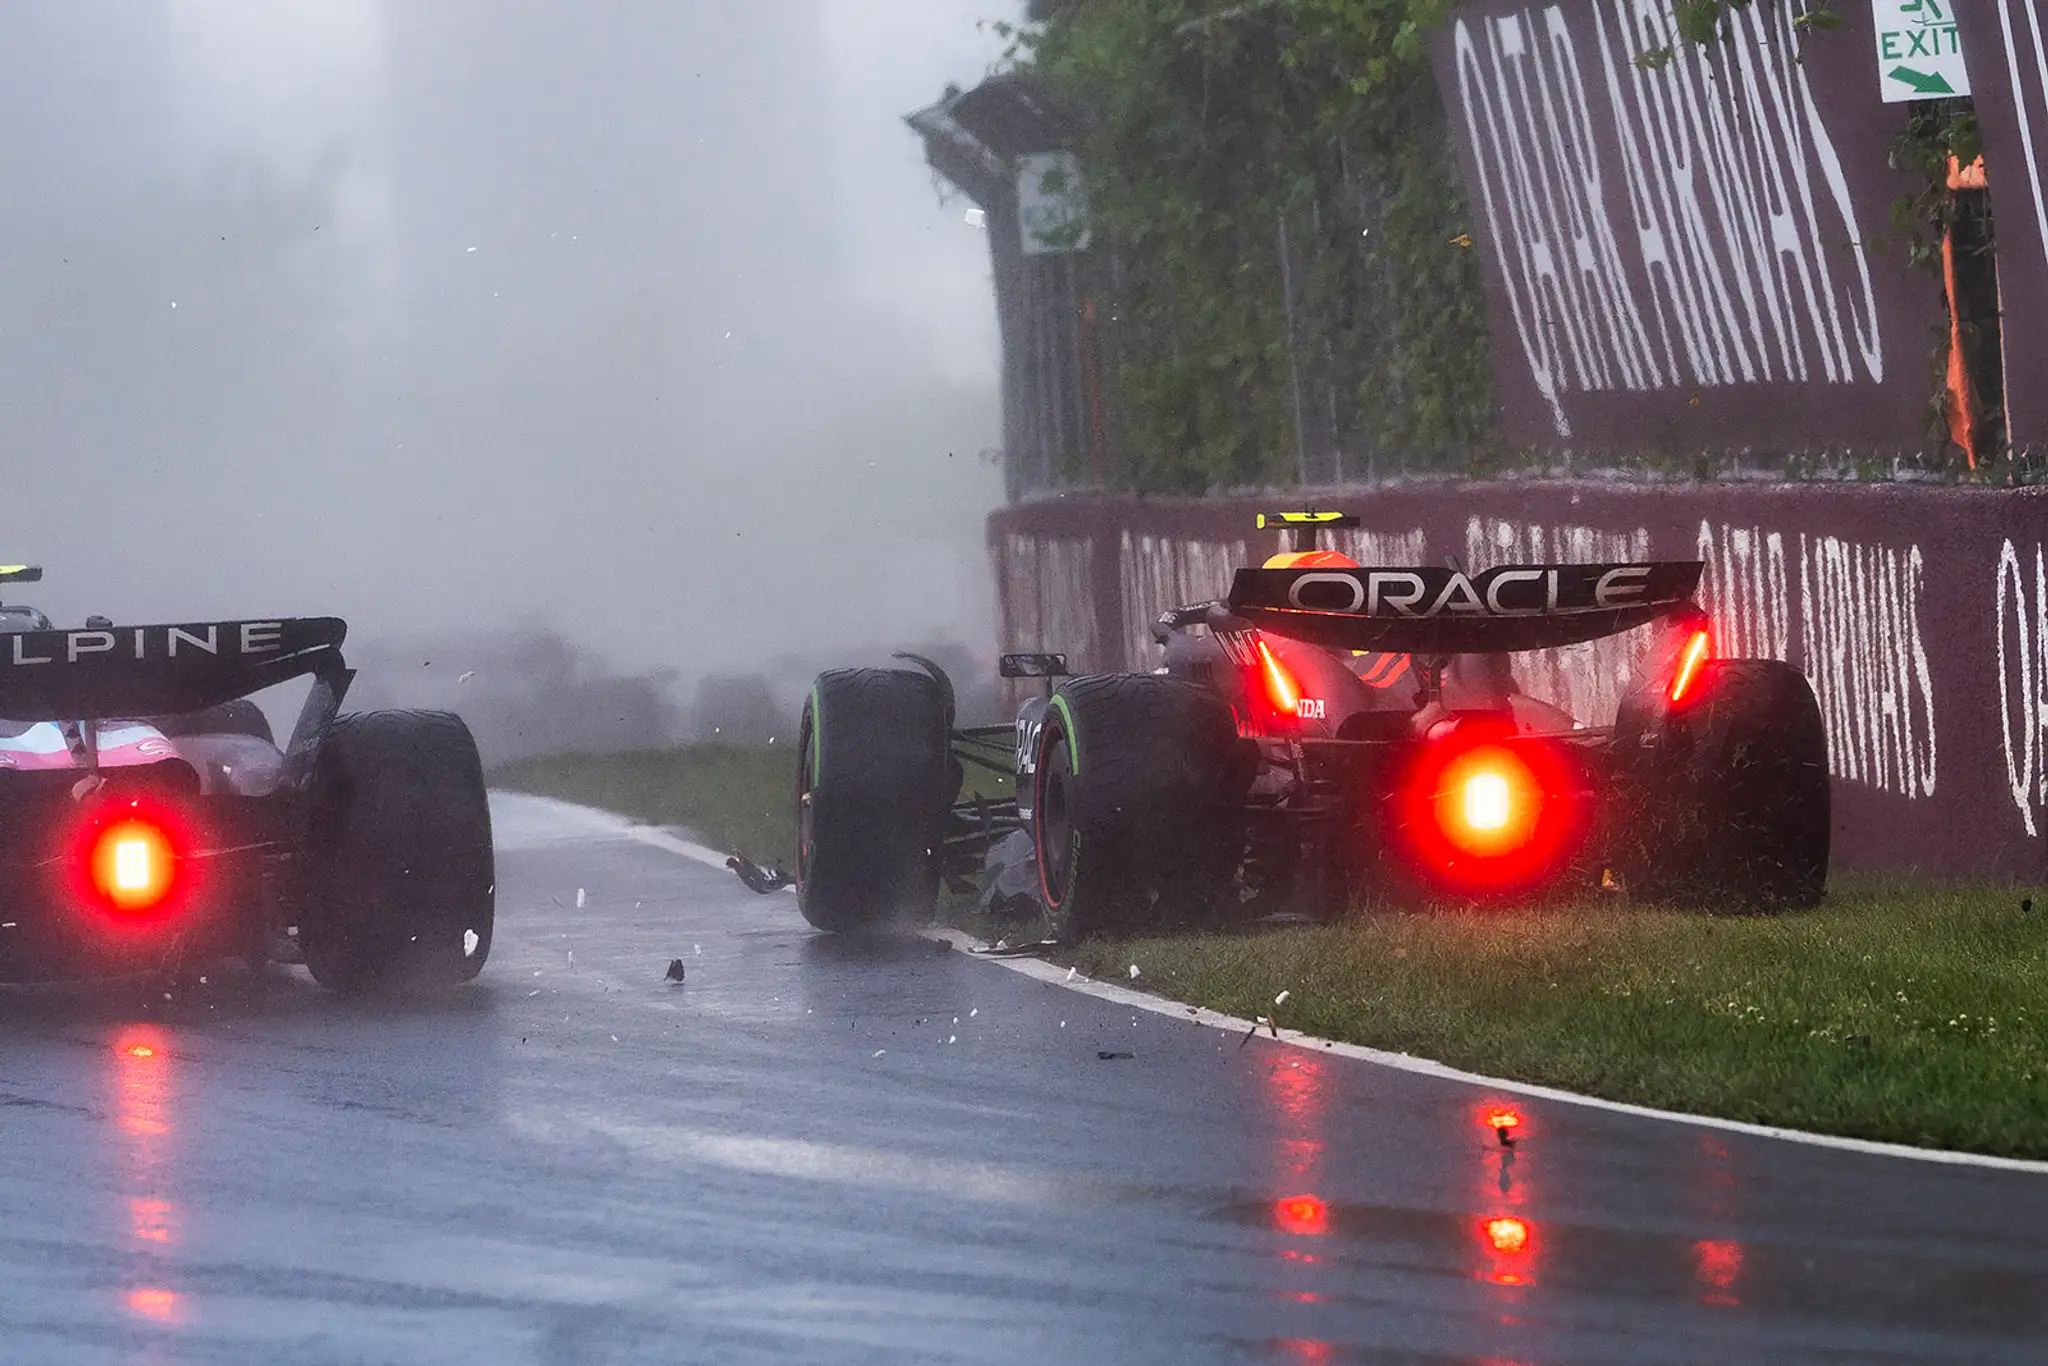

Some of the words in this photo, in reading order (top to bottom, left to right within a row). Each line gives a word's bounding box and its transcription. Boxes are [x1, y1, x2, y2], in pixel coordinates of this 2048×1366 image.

[1881, 27, 1959, 60] EXIT
[1455, 5, 1663, 438] QATAR
[1593, 0, 1883, 384] AIRWAYS
[1288, 567, 1652, 617] ORACLE
[13, 622, 282, 665] LPINE
[1295, 698, 1326, 718] NDA
